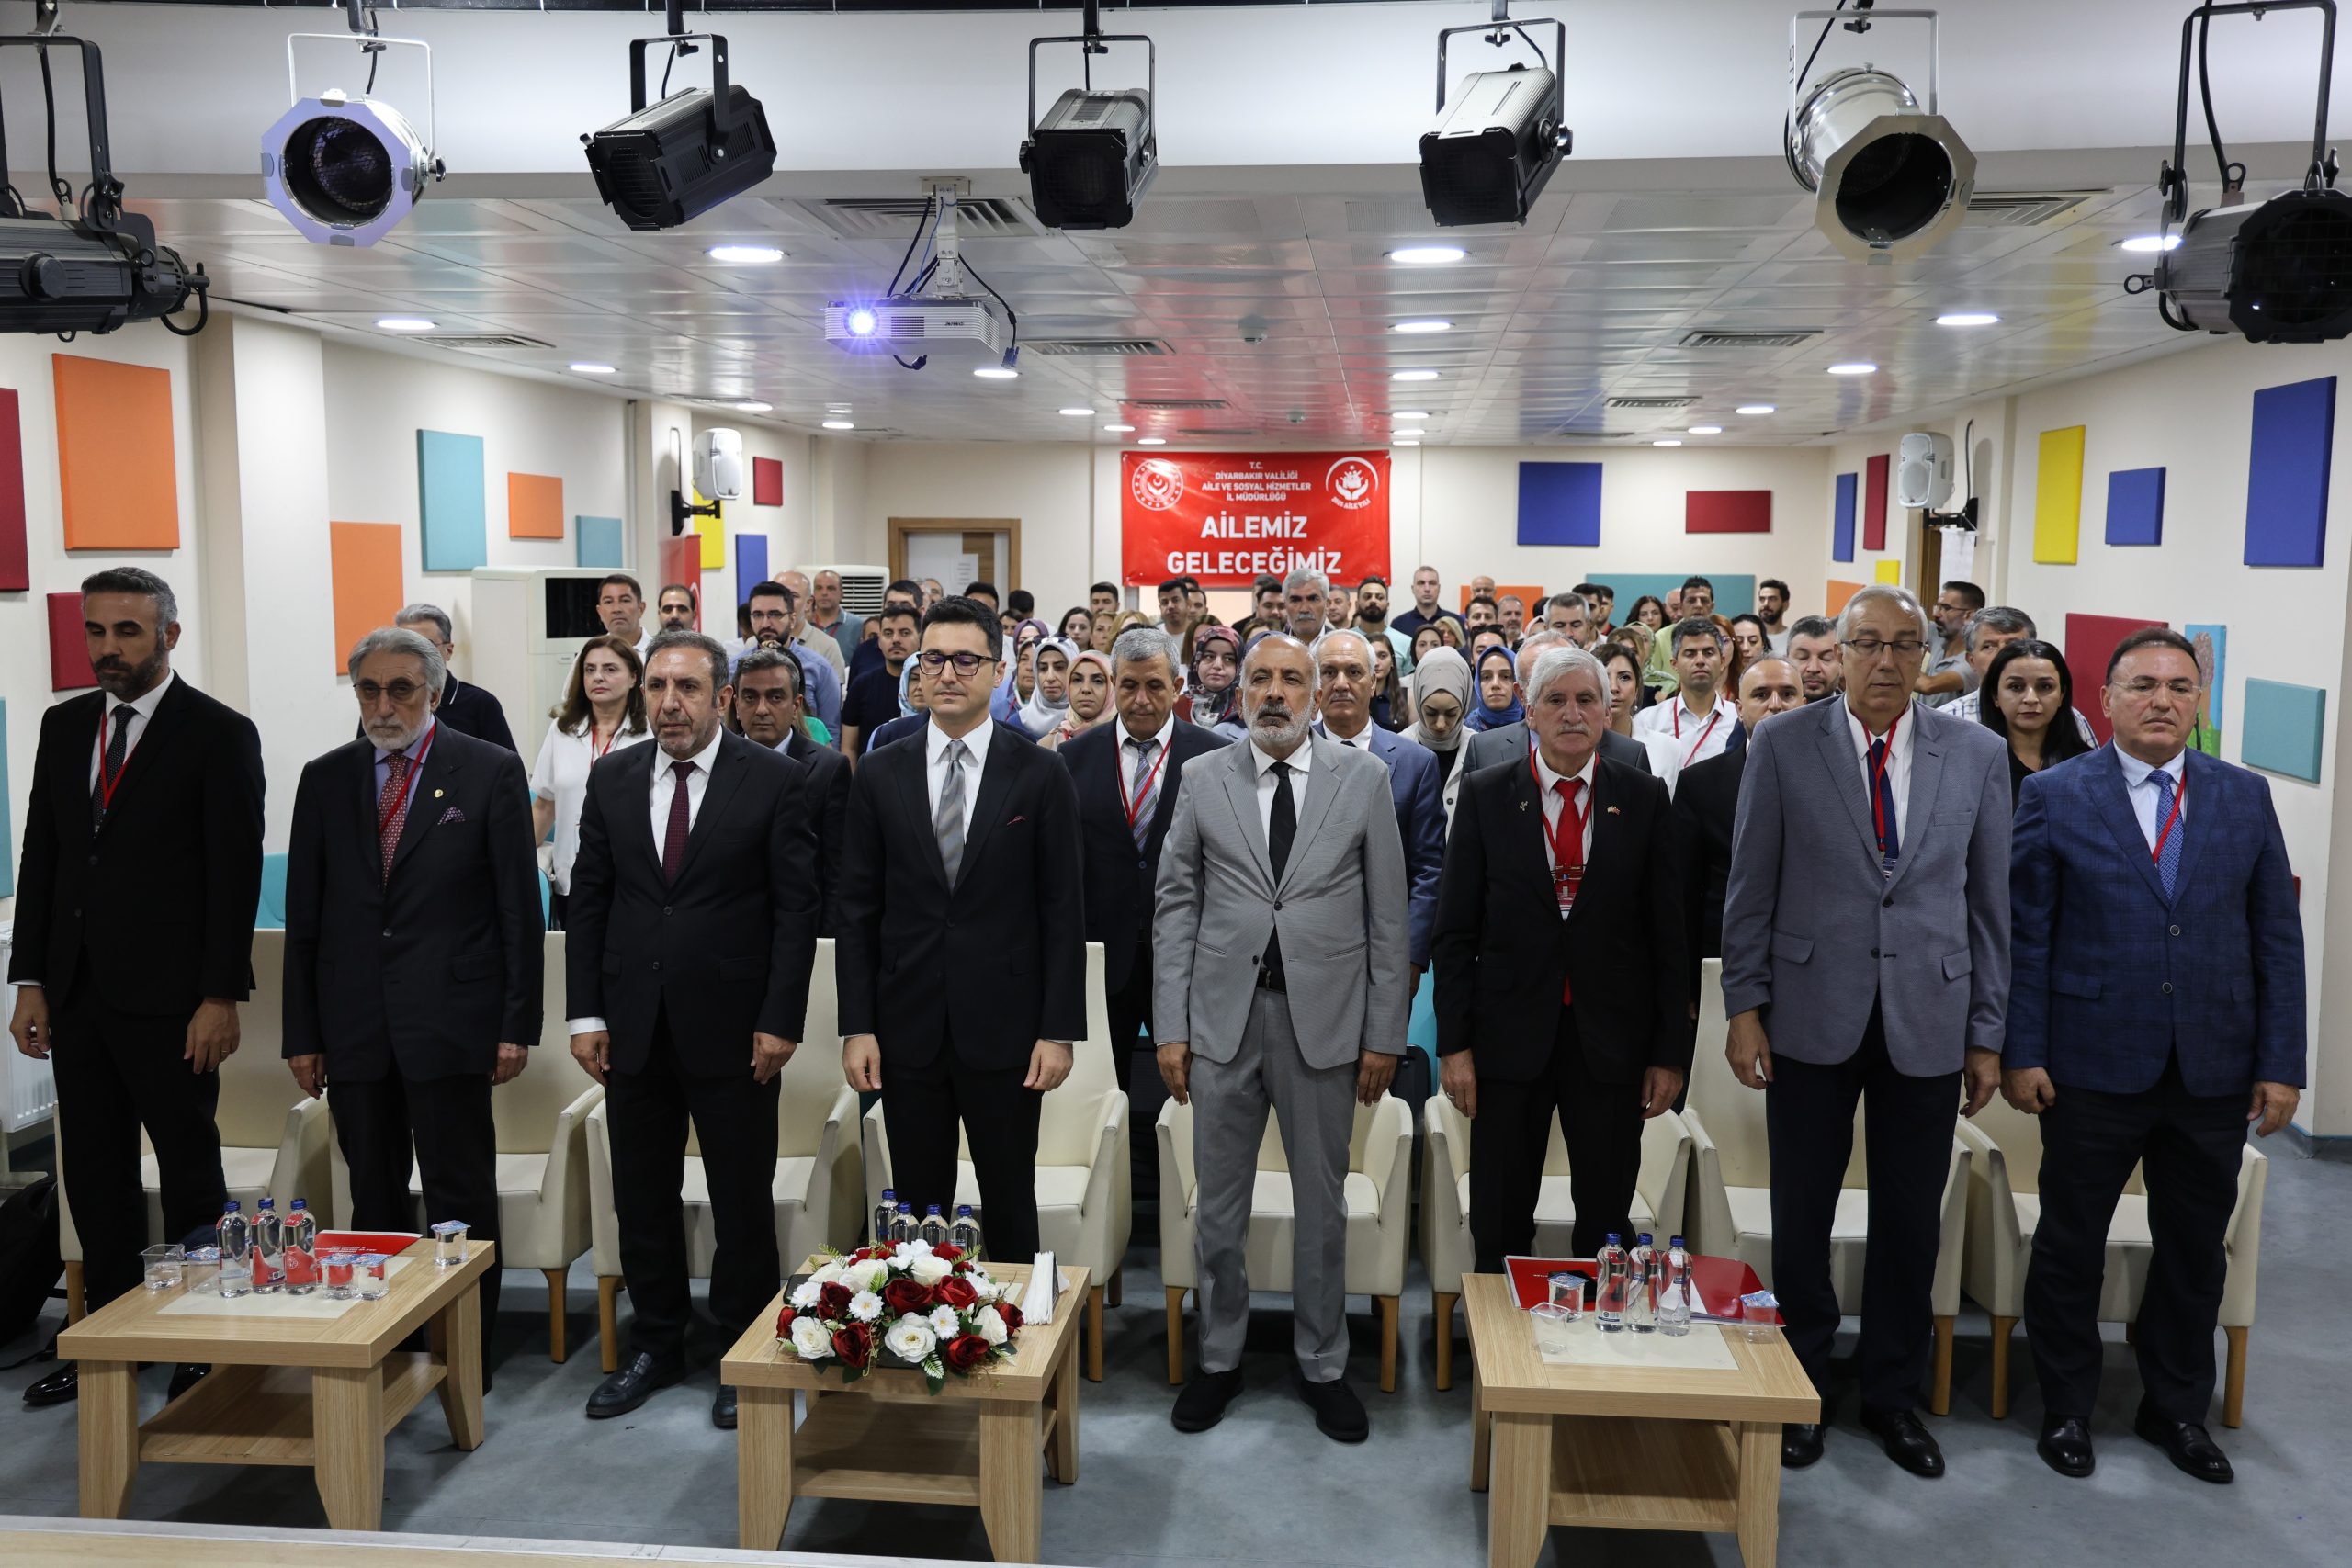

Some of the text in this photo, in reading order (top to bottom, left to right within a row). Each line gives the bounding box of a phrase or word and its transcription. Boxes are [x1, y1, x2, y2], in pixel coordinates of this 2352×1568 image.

[1250, 461, 1263, 469] T.C.
[1215, 470, 1298, 480] DİYARBAKIR VALİLİĞİ
[1202, 481, 1311, 491] AİLE VE SOSYAL HİZMETLER
[1226, 491, 1287, 502] İL MÜDÜRLÜĞÜ
[1200, 510, 1308, 539] AİLEMİZ
[1166, 545, 1342, 575] GELECEĞİMİZ
